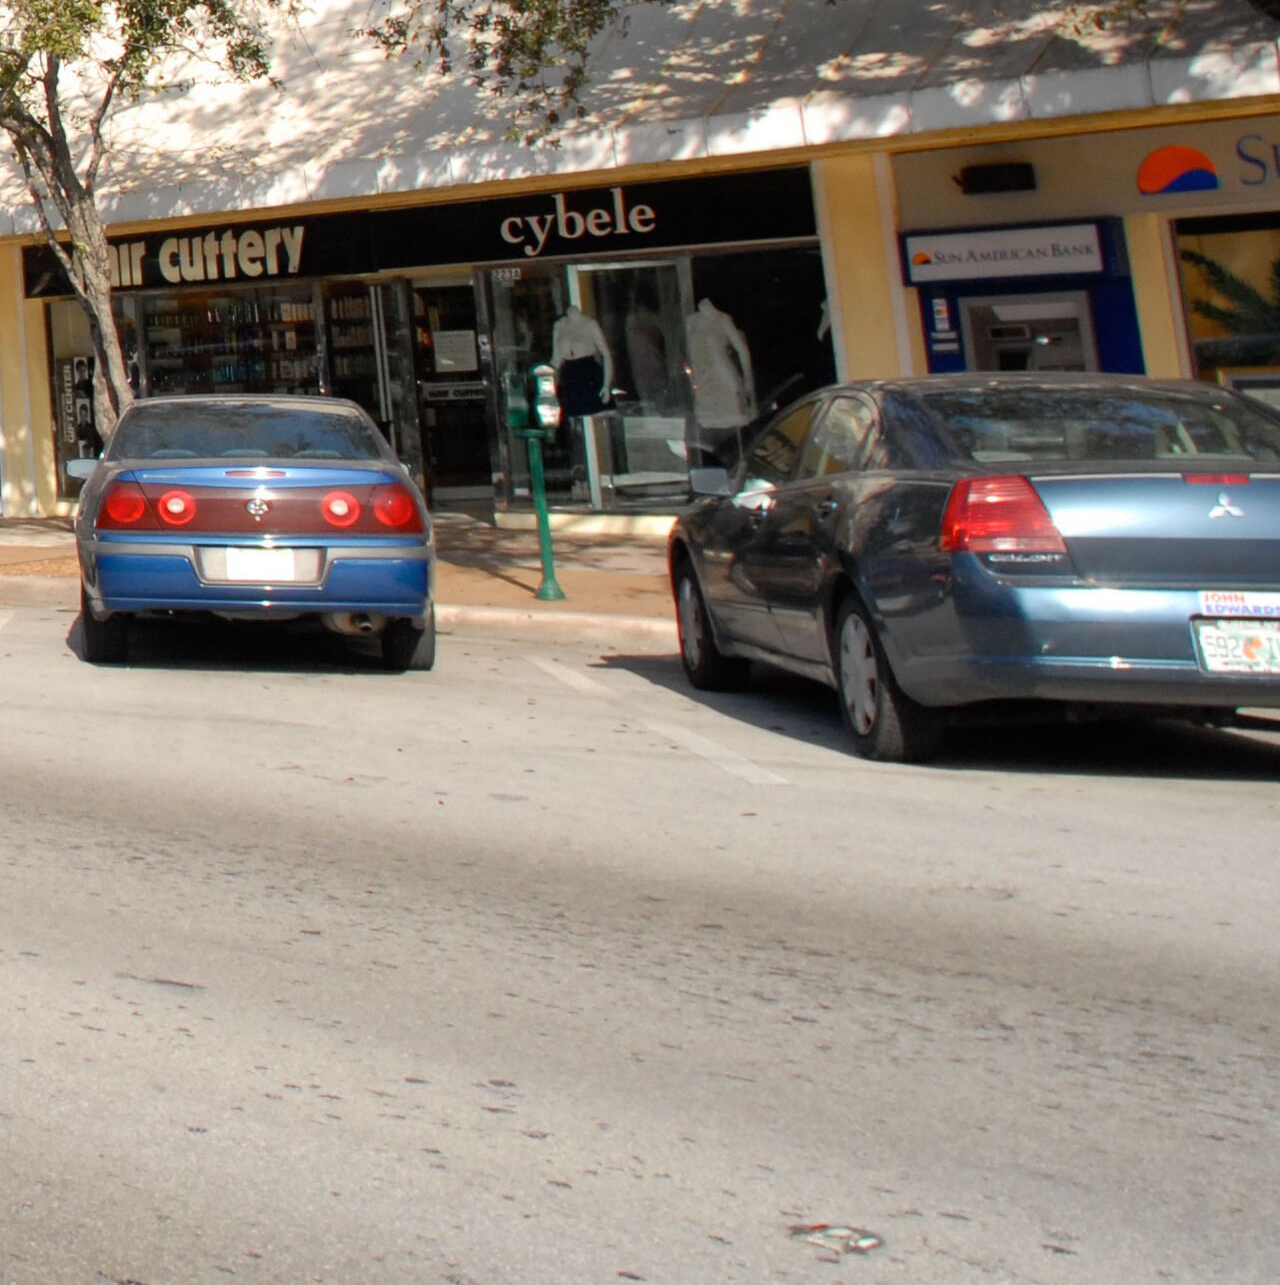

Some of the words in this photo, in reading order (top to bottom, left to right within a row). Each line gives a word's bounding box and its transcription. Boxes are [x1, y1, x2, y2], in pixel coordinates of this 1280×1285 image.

[1236, 134, 1280, 186] S
[500, 187, 656, 256] cybele
[159, 225, 305, 283] cuttery
[63, 364, 74, 413] CENTER
[66, 415, 75, 443] GIFT
[1203, 592, 1245, 604] JOHN
